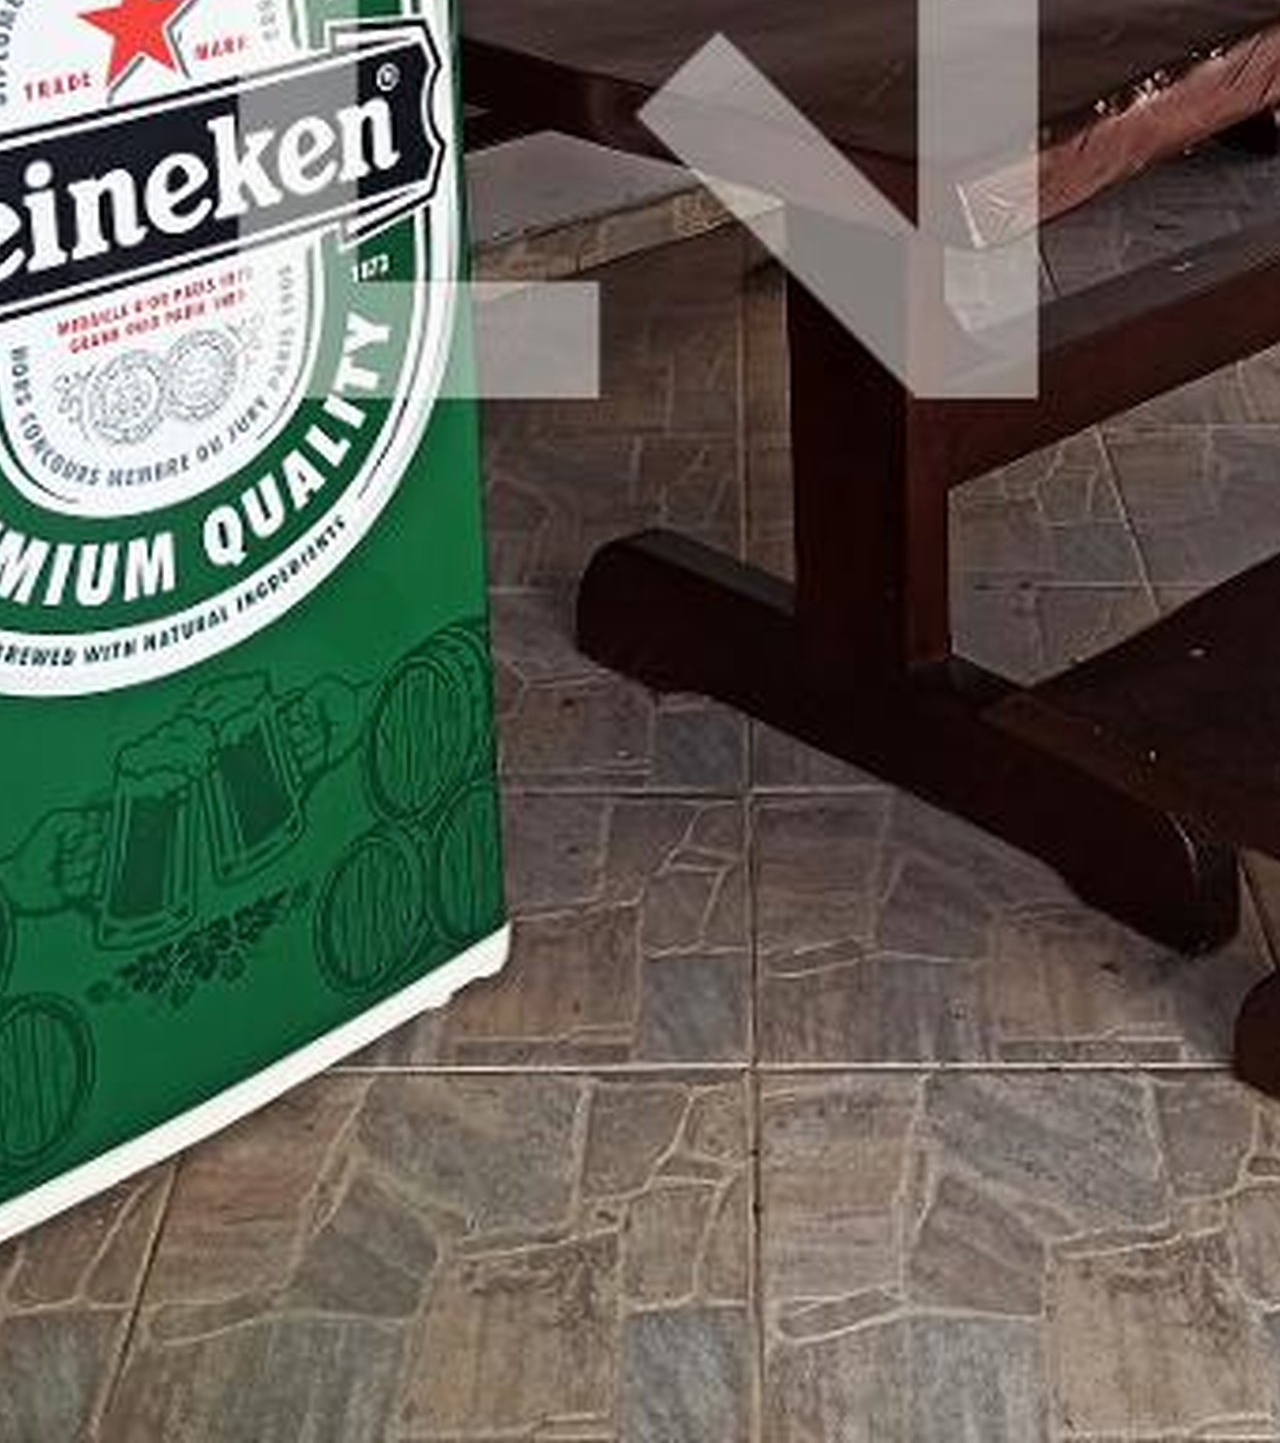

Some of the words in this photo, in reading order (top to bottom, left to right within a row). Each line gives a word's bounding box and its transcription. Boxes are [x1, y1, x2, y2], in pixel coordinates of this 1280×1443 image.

[22, 71, 92, 103] TRADE
[202, 311, 392, 568] QUALITY
[82, 638, 138, 664] WITH
[142, 604, 230, 654] NATURAL
